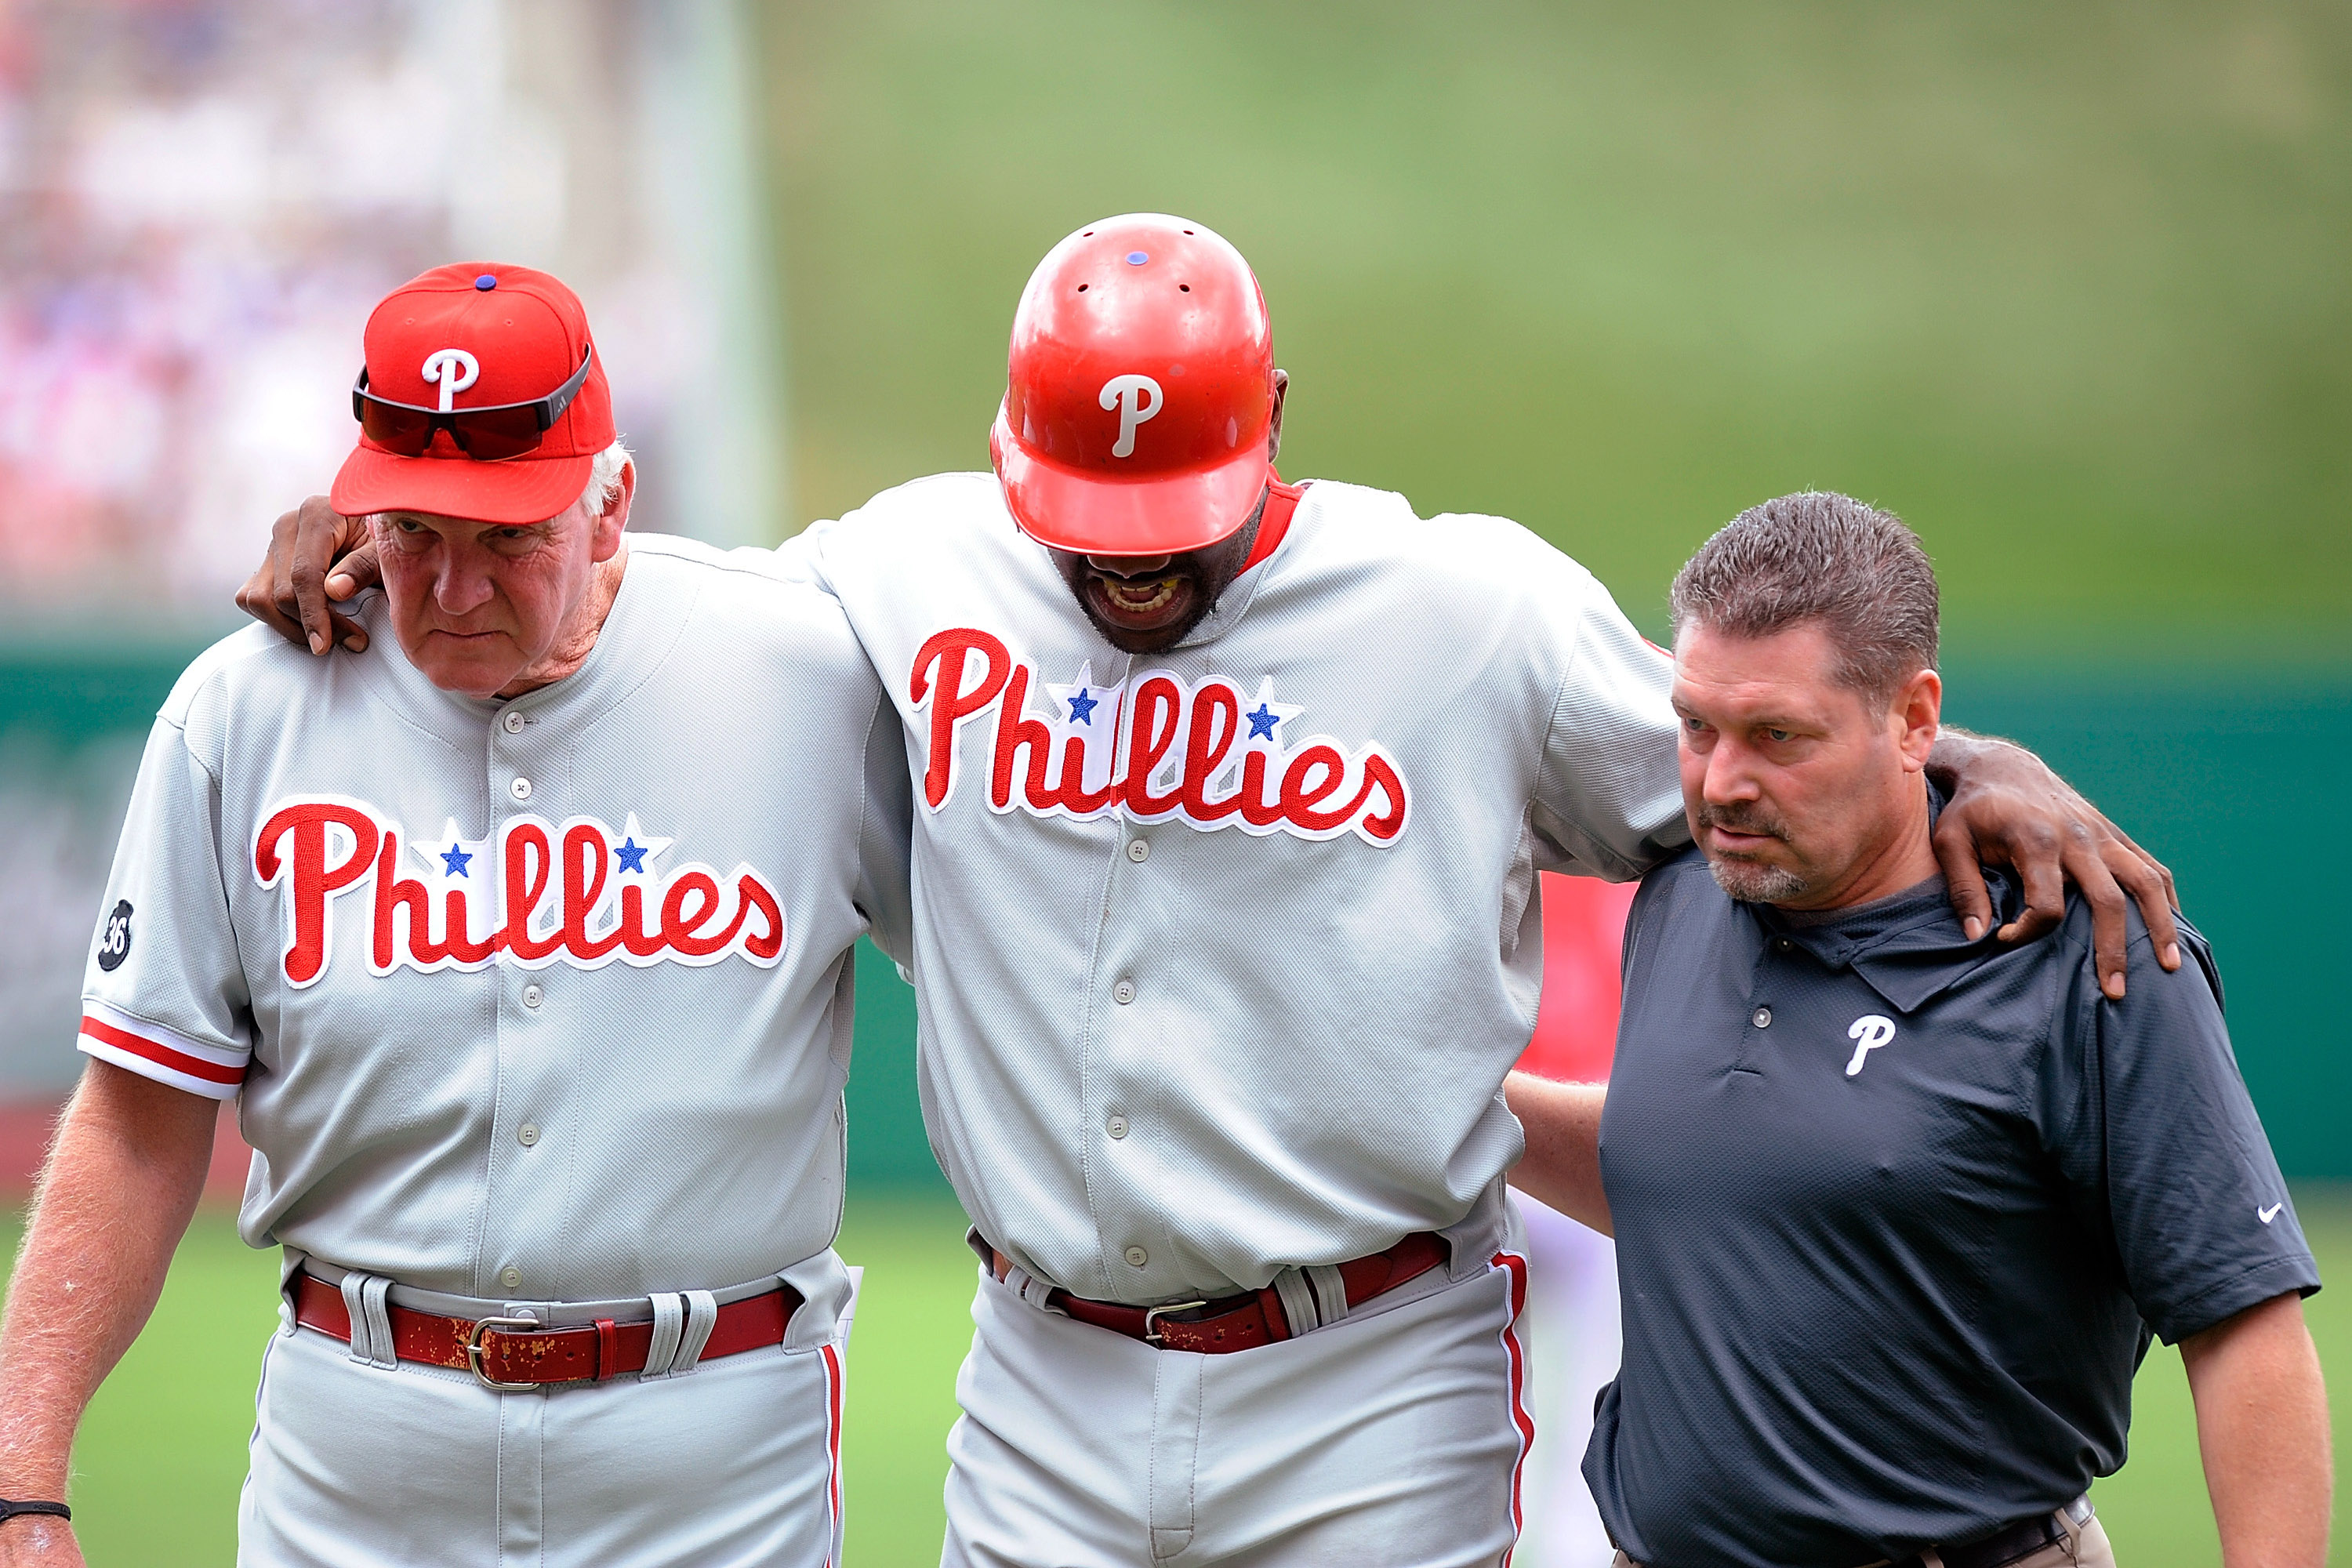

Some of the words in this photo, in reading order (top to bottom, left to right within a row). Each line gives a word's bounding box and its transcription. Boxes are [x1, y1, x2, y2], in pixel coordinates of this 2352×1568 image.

[421, 348, 480, 412] P
[1099, 374, 1163, 458] P
[910, 628, 1406, 839] Phillies
[256, 804, 783, 983] Phillies
[103, 916, 127, 954] 36
[1845, 1014, 1896, 1076] P
